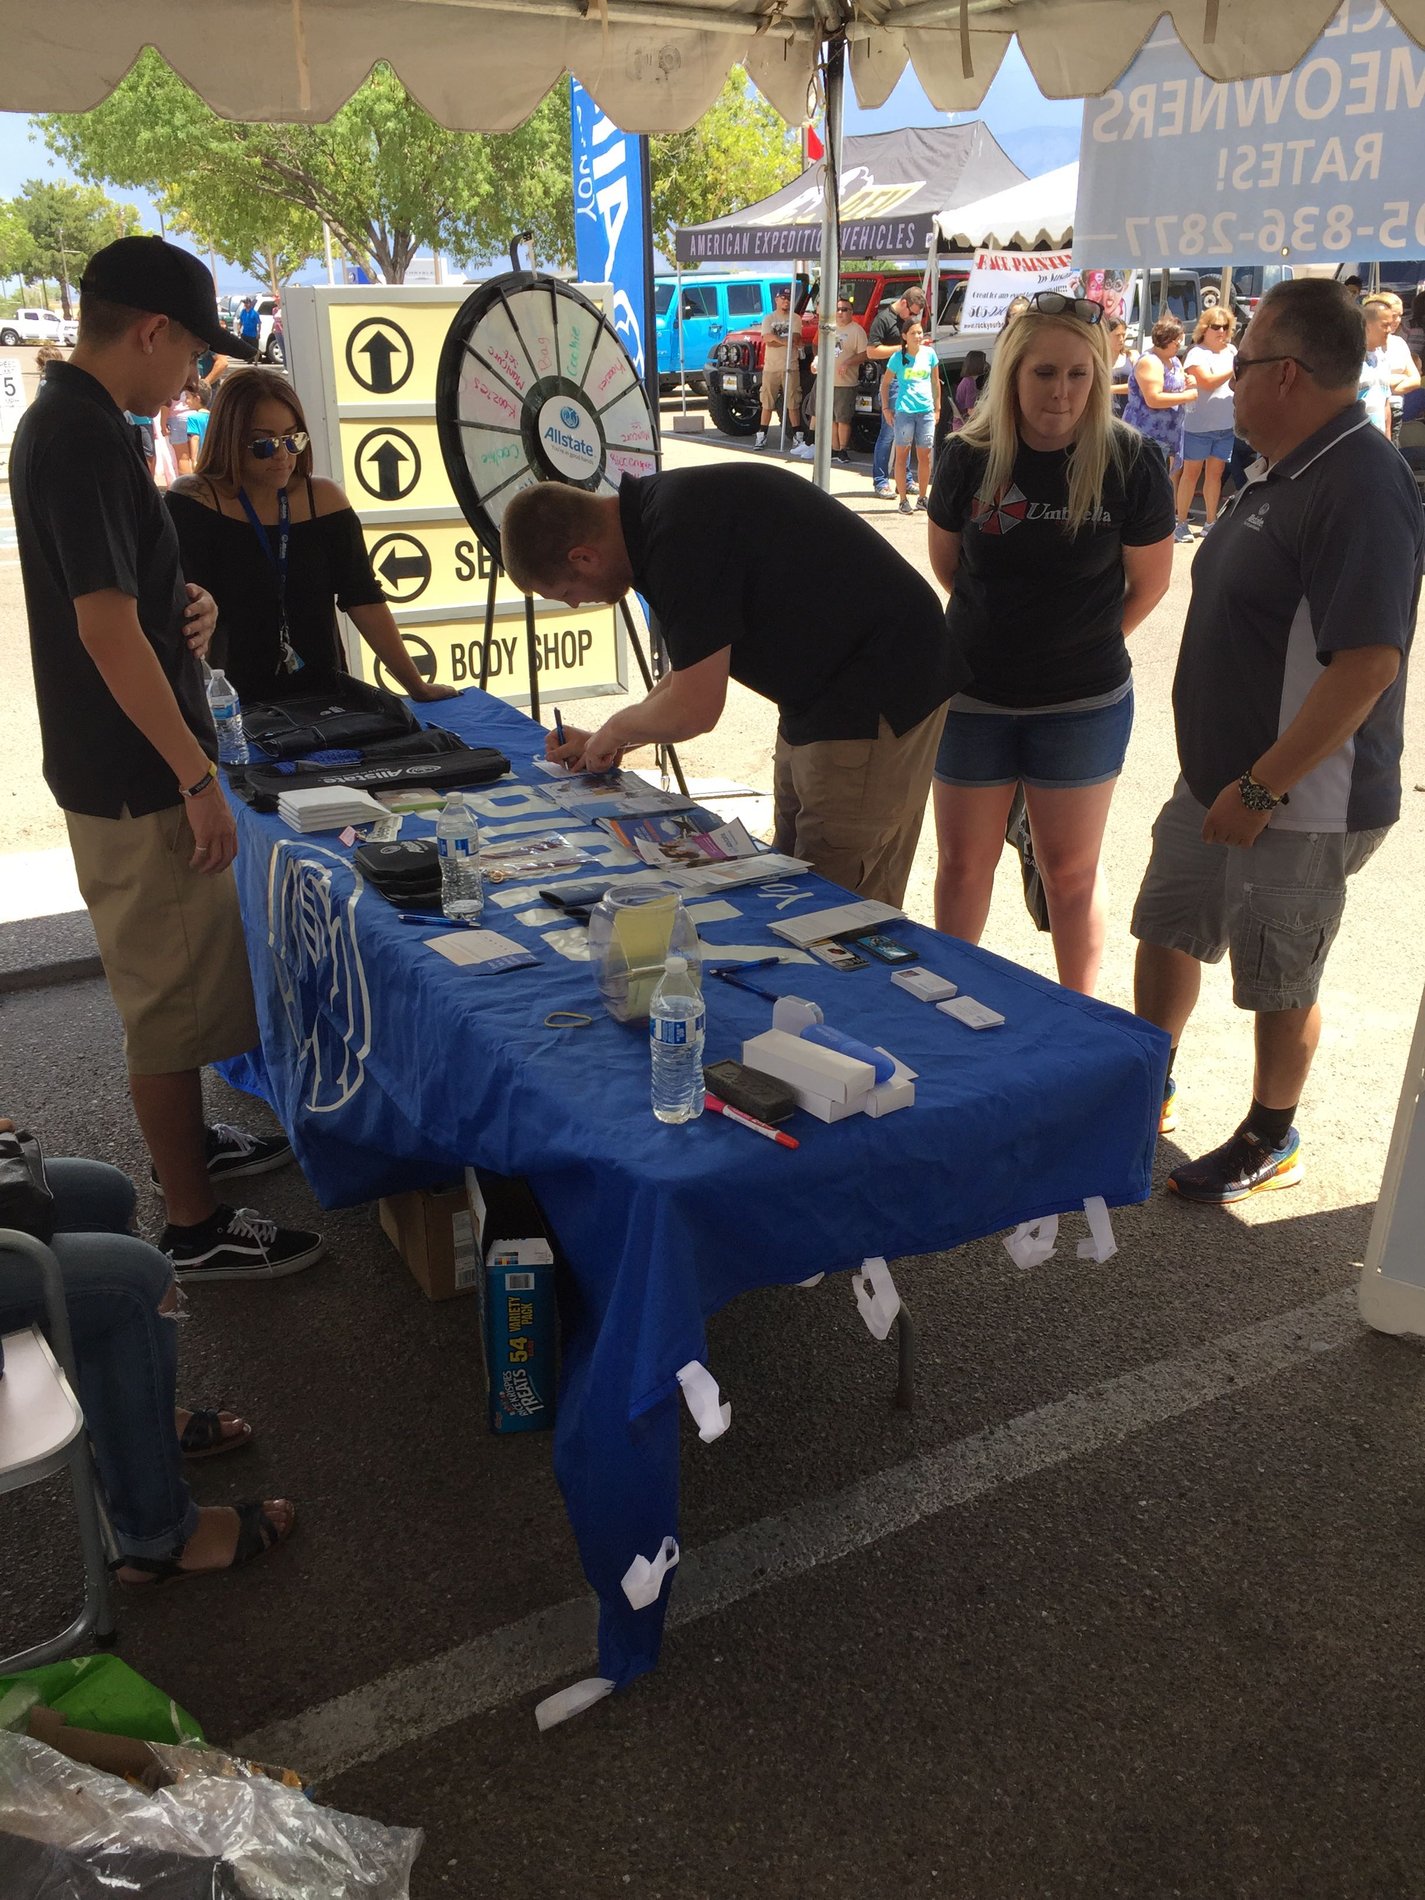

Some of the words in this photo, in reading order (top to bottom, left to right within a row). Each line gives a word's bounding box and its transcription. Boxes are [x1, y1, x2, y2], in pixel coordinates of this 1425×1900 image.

[690, 232, 750, 256] AMERICAN
[755, 229, 823, 254] EXPEDITI
[841, 222, 915, 251] VEHICLES
[976, 254, 1010, 271] FACE
[544, 427, 594, 457] Allstate
[1026, 502, 1112, 522] Umbella
[450, 636, 518, 682] BODY
[324, 768, 403, 784] Allstate
[508, 1296, 521, 1332] VARIETY
[521, 1302, 533, 1325] PACK
[509, 1336, 529, 1363] 54
[512, 1368, 545, 1415] TREATS
